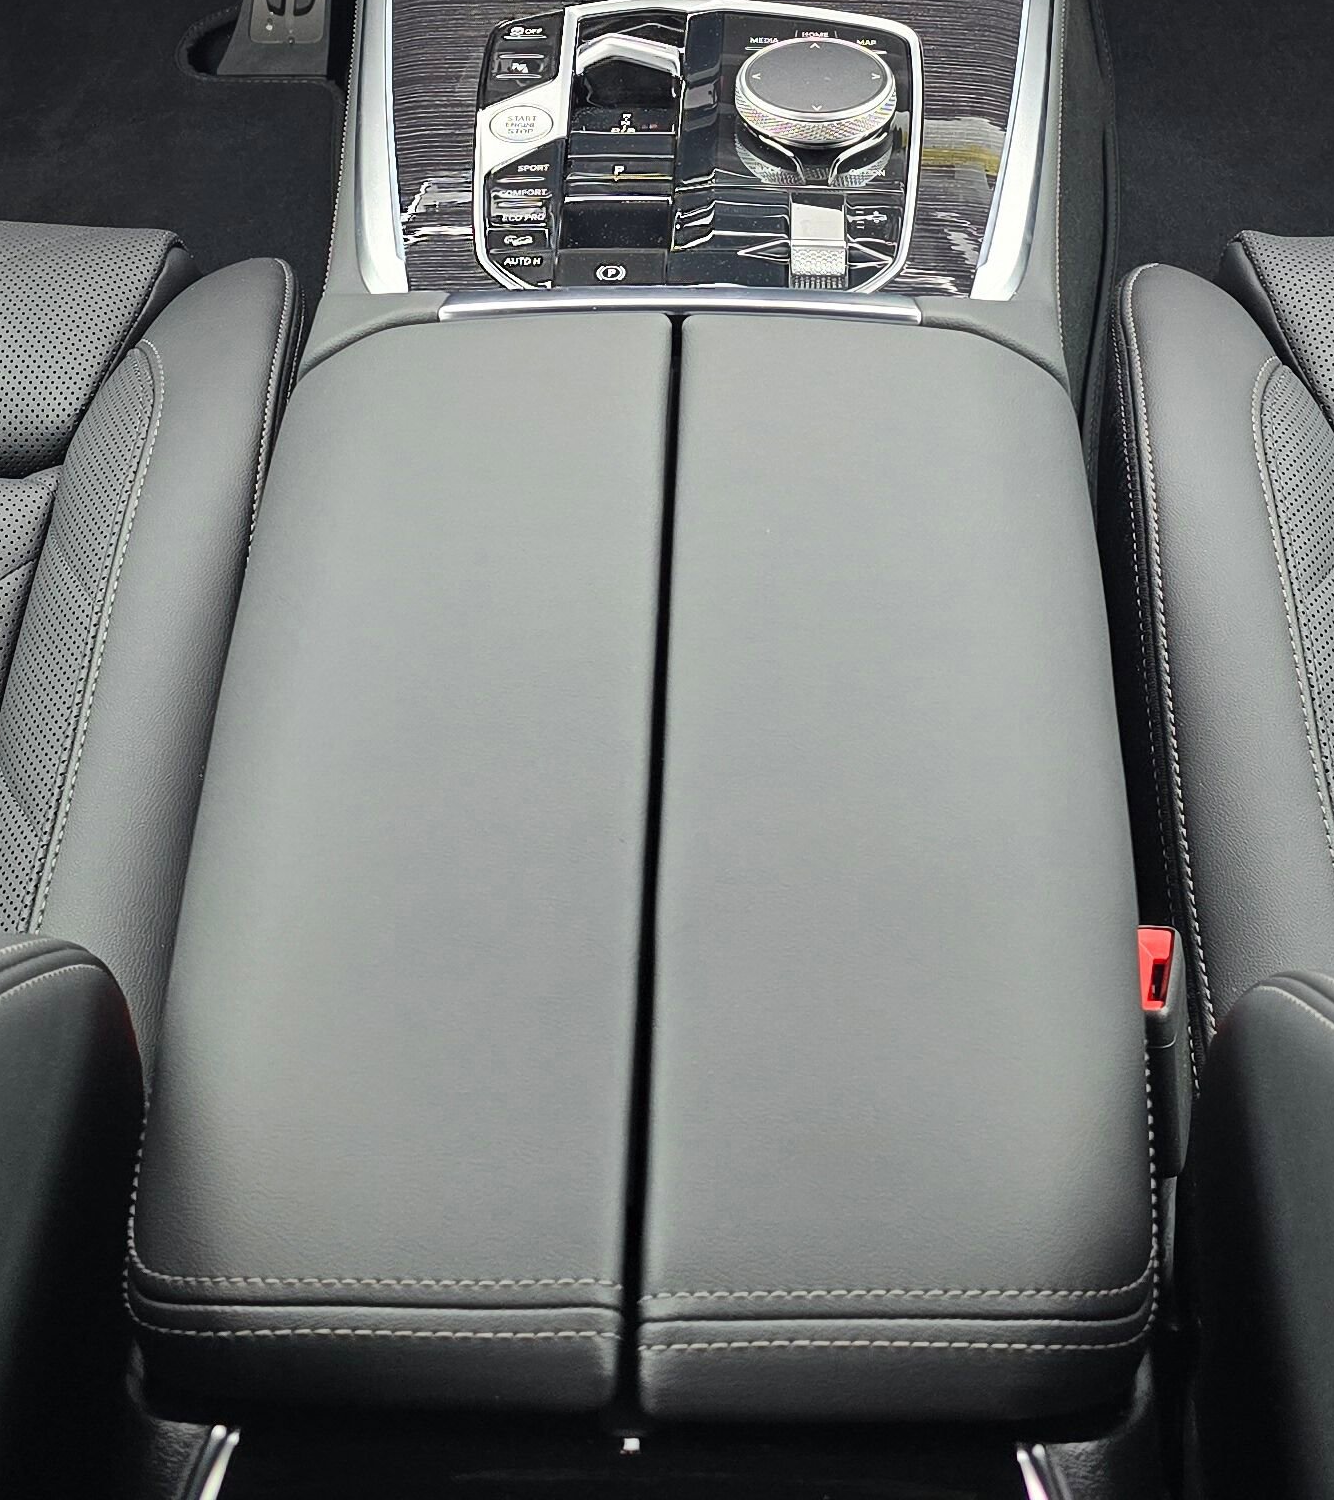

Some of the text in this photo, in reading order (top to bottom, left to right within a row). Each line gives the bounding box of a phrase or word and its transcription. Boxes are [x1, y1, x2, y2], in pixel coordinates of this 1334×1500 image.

[518, 164, 549, 172] SPORT
[504, 257, 541, 266] AUTO H
